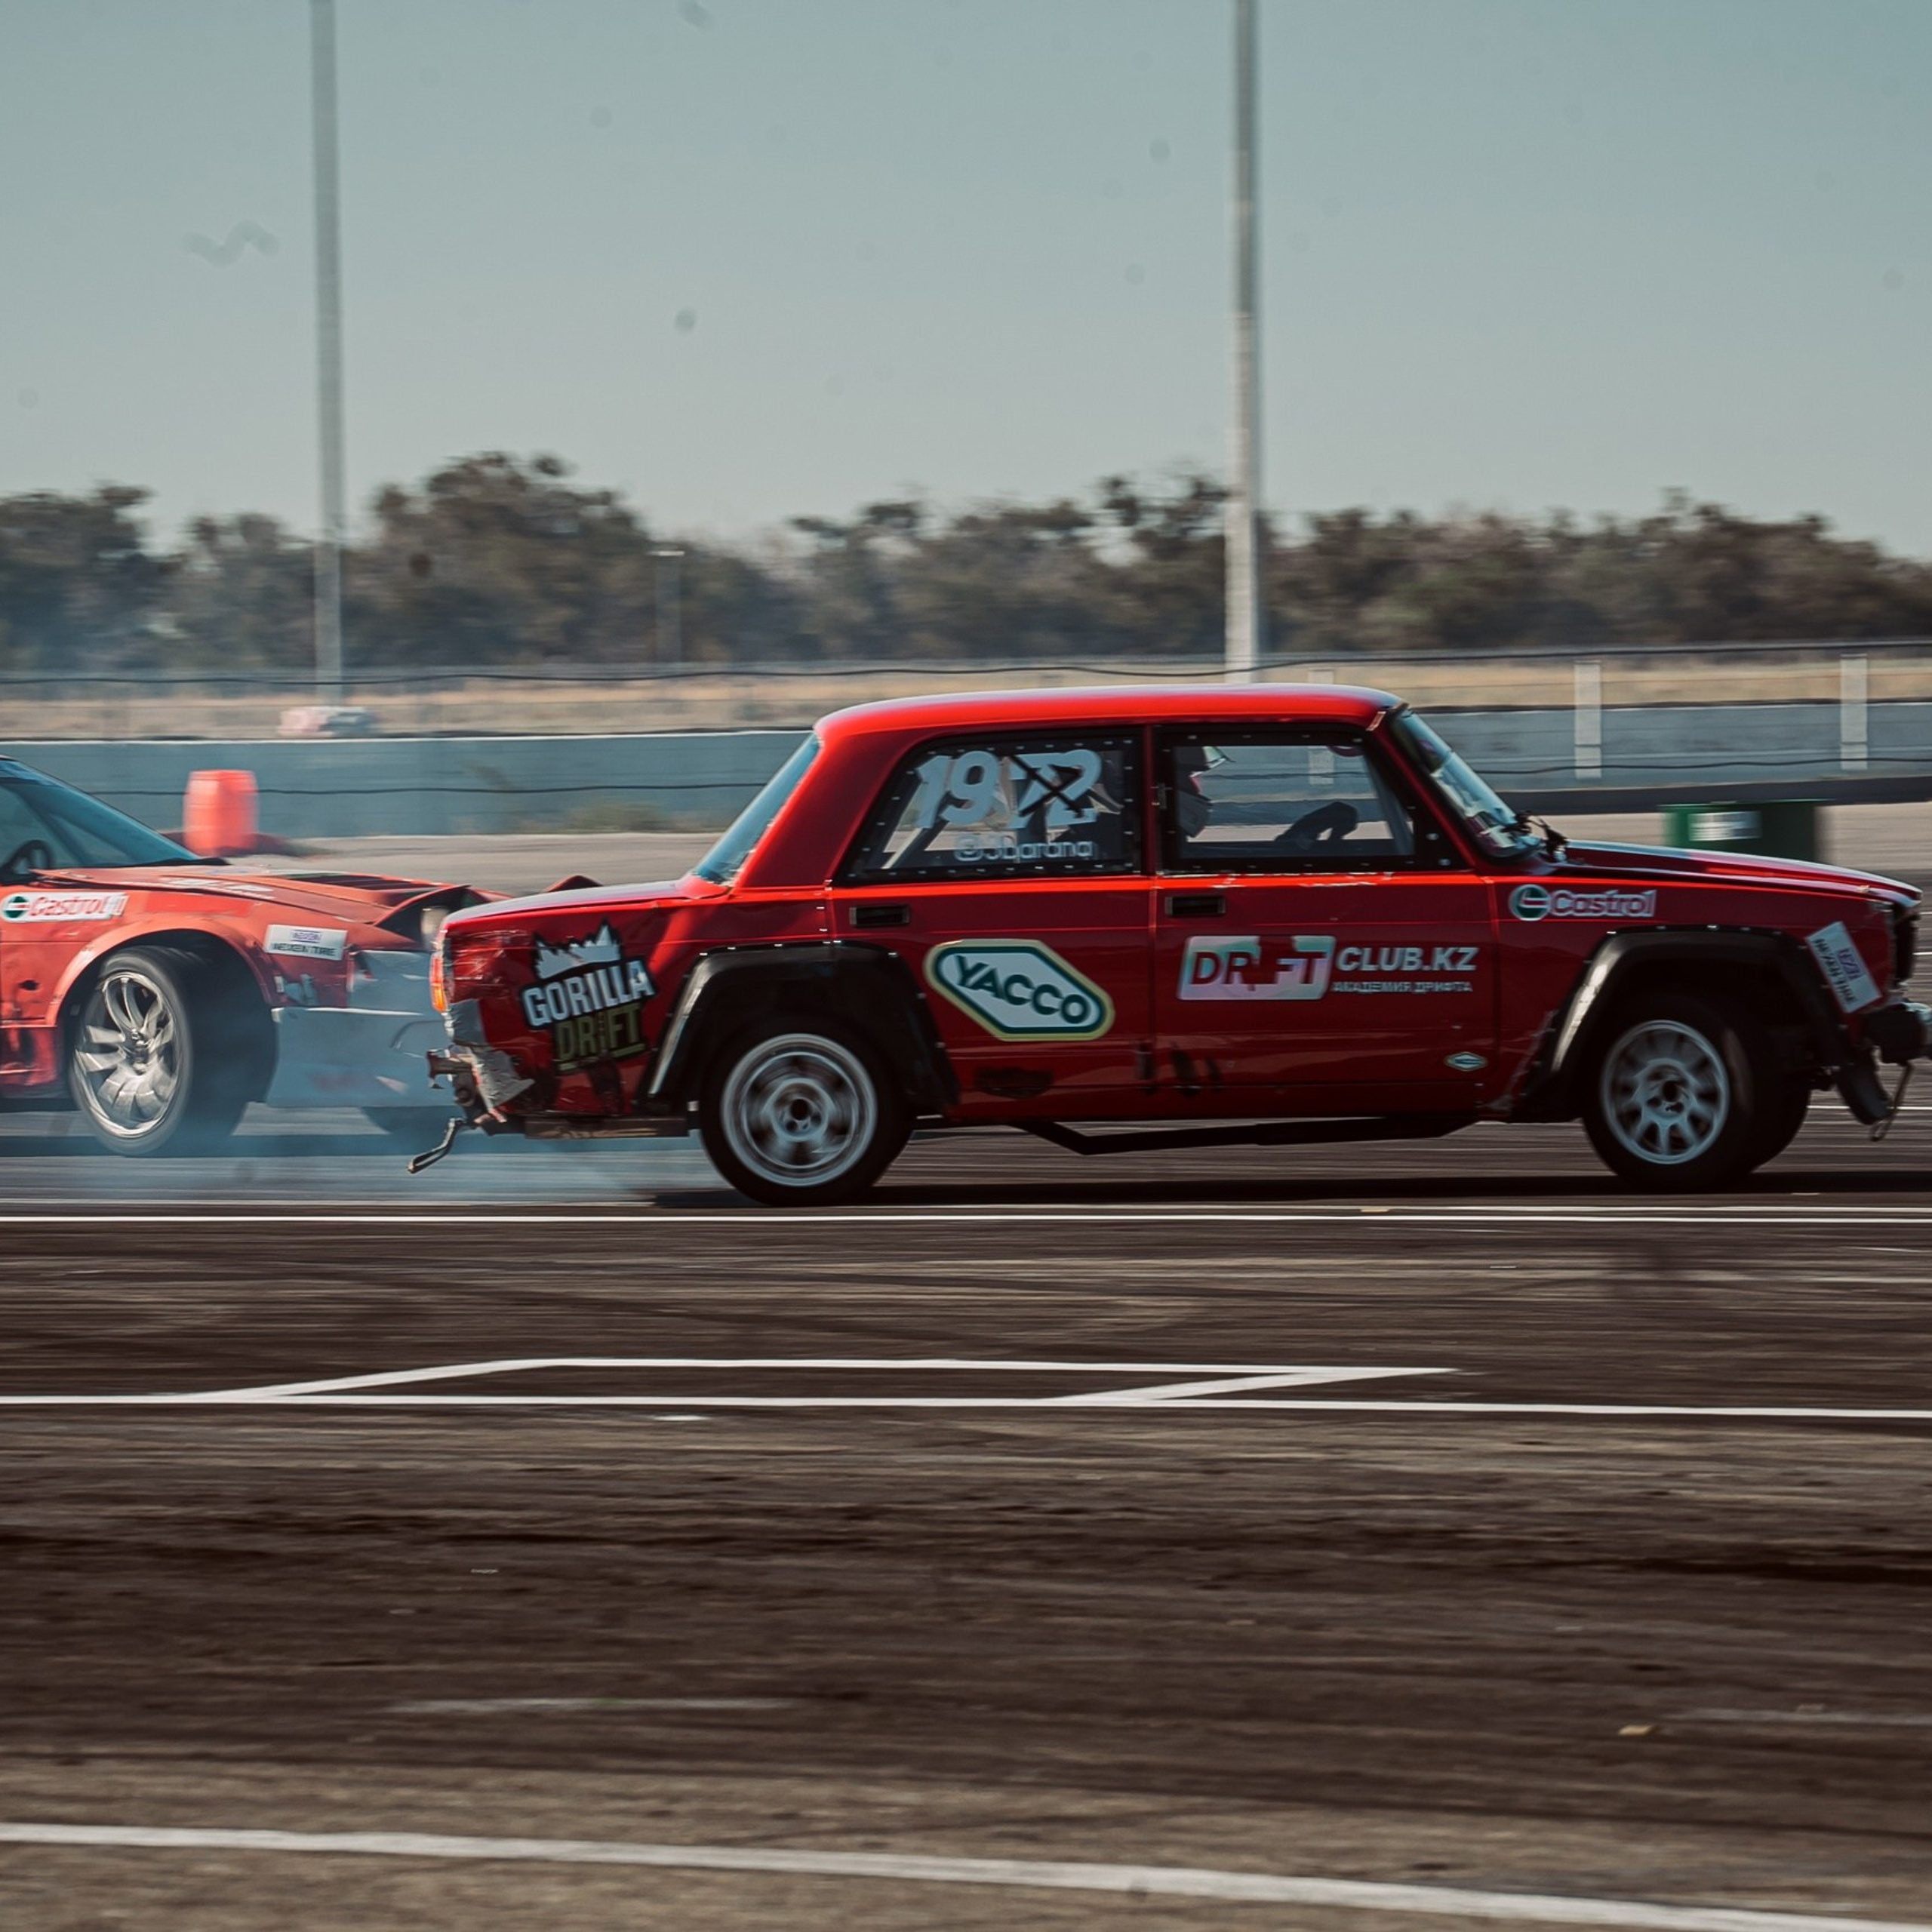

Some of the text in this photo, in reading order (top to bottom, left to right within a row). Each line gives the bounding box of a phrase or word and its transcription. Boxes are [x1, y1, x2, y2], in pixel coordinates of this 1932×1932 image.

[29, 895, 113, 917] Castrol
[1549, 889, 1657, 918] Castrol
[1336, 946, 1480, 972] CLUB.KZ
[523, 960, 655, 1026] GORILLA
[954, 955, 1090, 1024] YACCO
